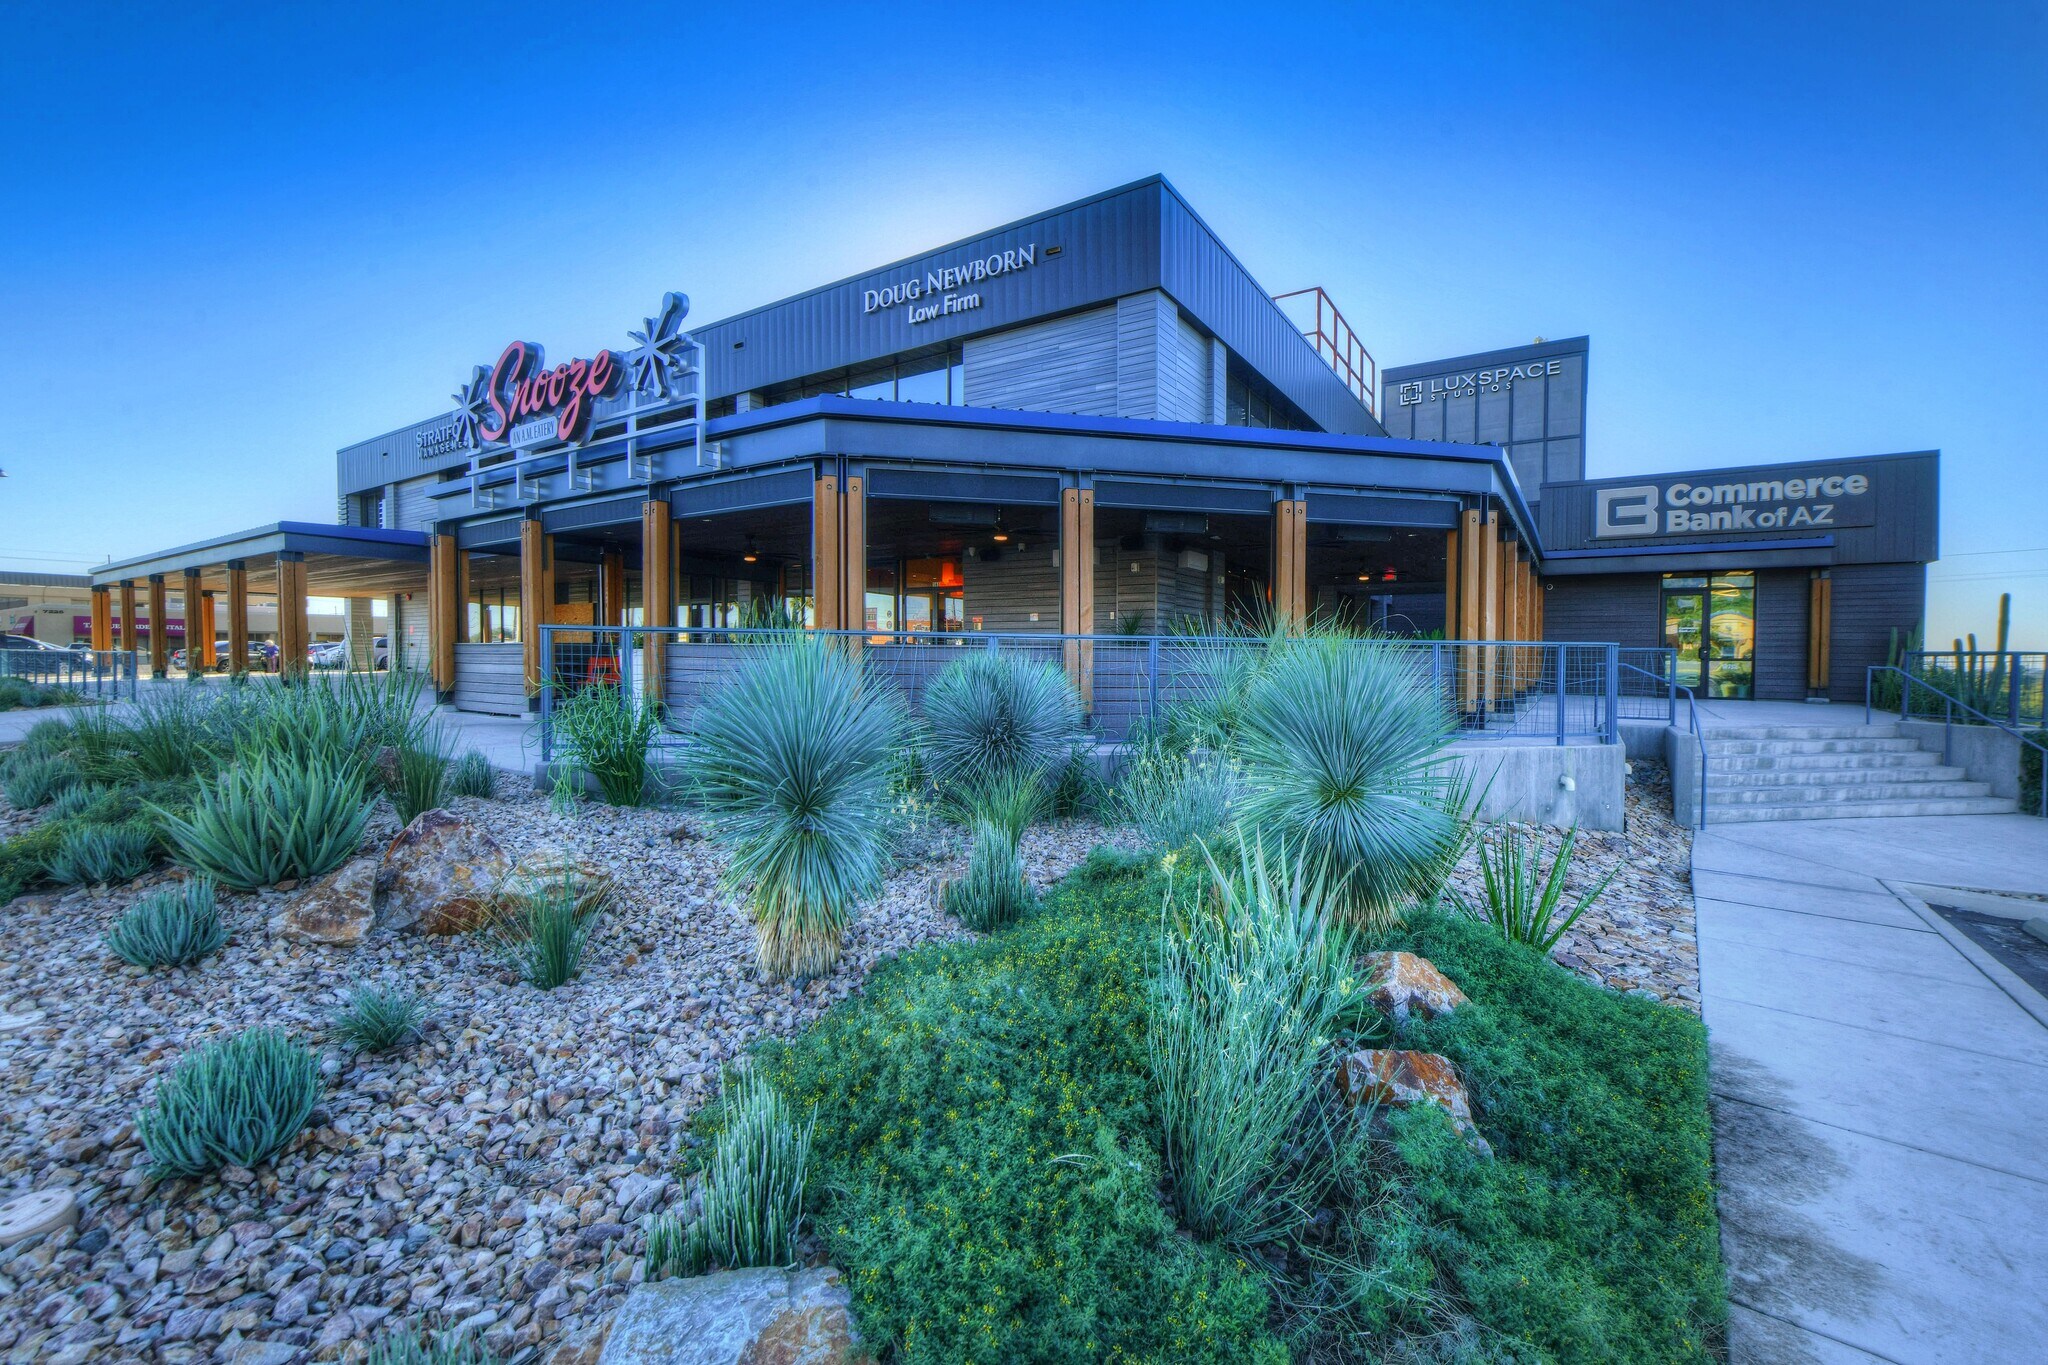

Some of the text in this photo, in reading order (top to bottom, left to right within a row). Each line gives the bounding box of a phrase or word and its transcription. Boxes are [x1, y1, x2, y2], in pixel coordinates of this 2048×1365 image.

[864, 243, 1036, 313] DOUG NEWBORN
[908, 292, 980, 324] Law Firm
[480, 340, 613, 441] Snooze
[1430, 360, 1561, 393] LUXSPACE
[1430, 382, 1512, 402] STUDIOS
[512, 430, 521, 445] AN
[533, 419, 554, 439] EATERY
[1665, 474, 1869, 508] Commerce
[1665, 504, 1835, 534] Bank of AZ
